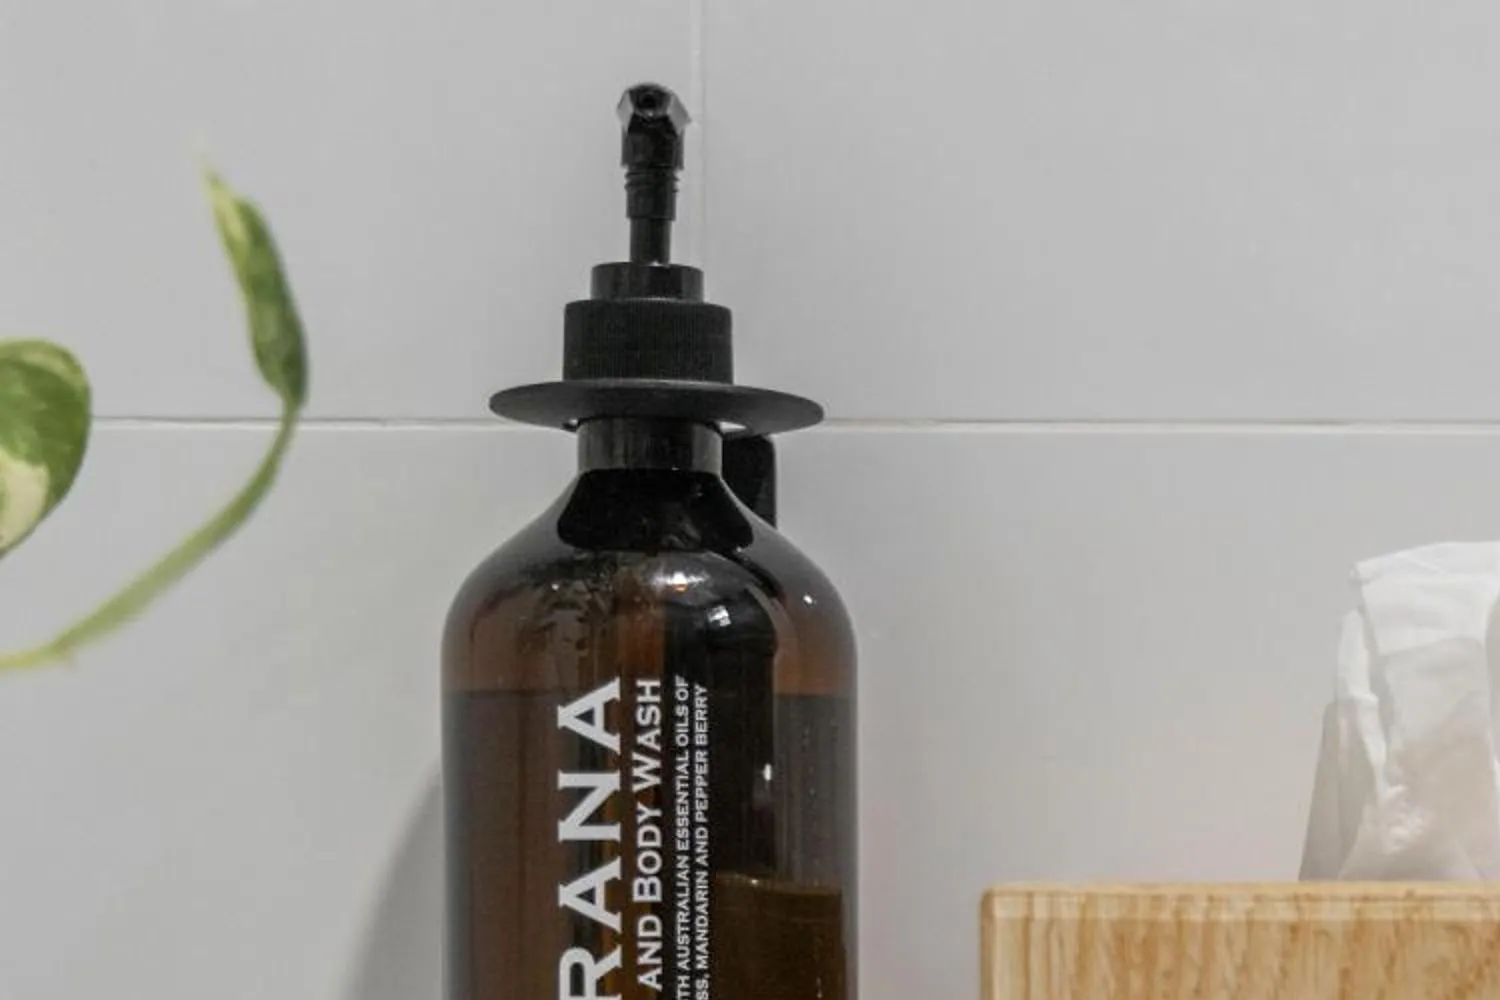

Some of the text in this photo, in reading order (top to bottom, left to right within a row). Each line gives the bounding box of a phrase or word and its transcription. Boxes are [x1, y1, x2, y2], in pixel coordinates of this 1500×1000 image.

[676, 675, 688, 701] OF
[676, 705, 688, 746] OILS
[695, 684, 707, 745] BERRY
[632, 680, 661, 792] WASH
[676, 751, 689, 850] ESSENTIAL
[695, 750, 708, 822] PEPPER
[633, 802, 661, 902] BODY
[695, 827, 708, 865] AND
[677, 856, 690, 970] AUSTRALIAN
[695, 871, 708, 969] MANDARIN
[638, 915, 662, 990] AND
